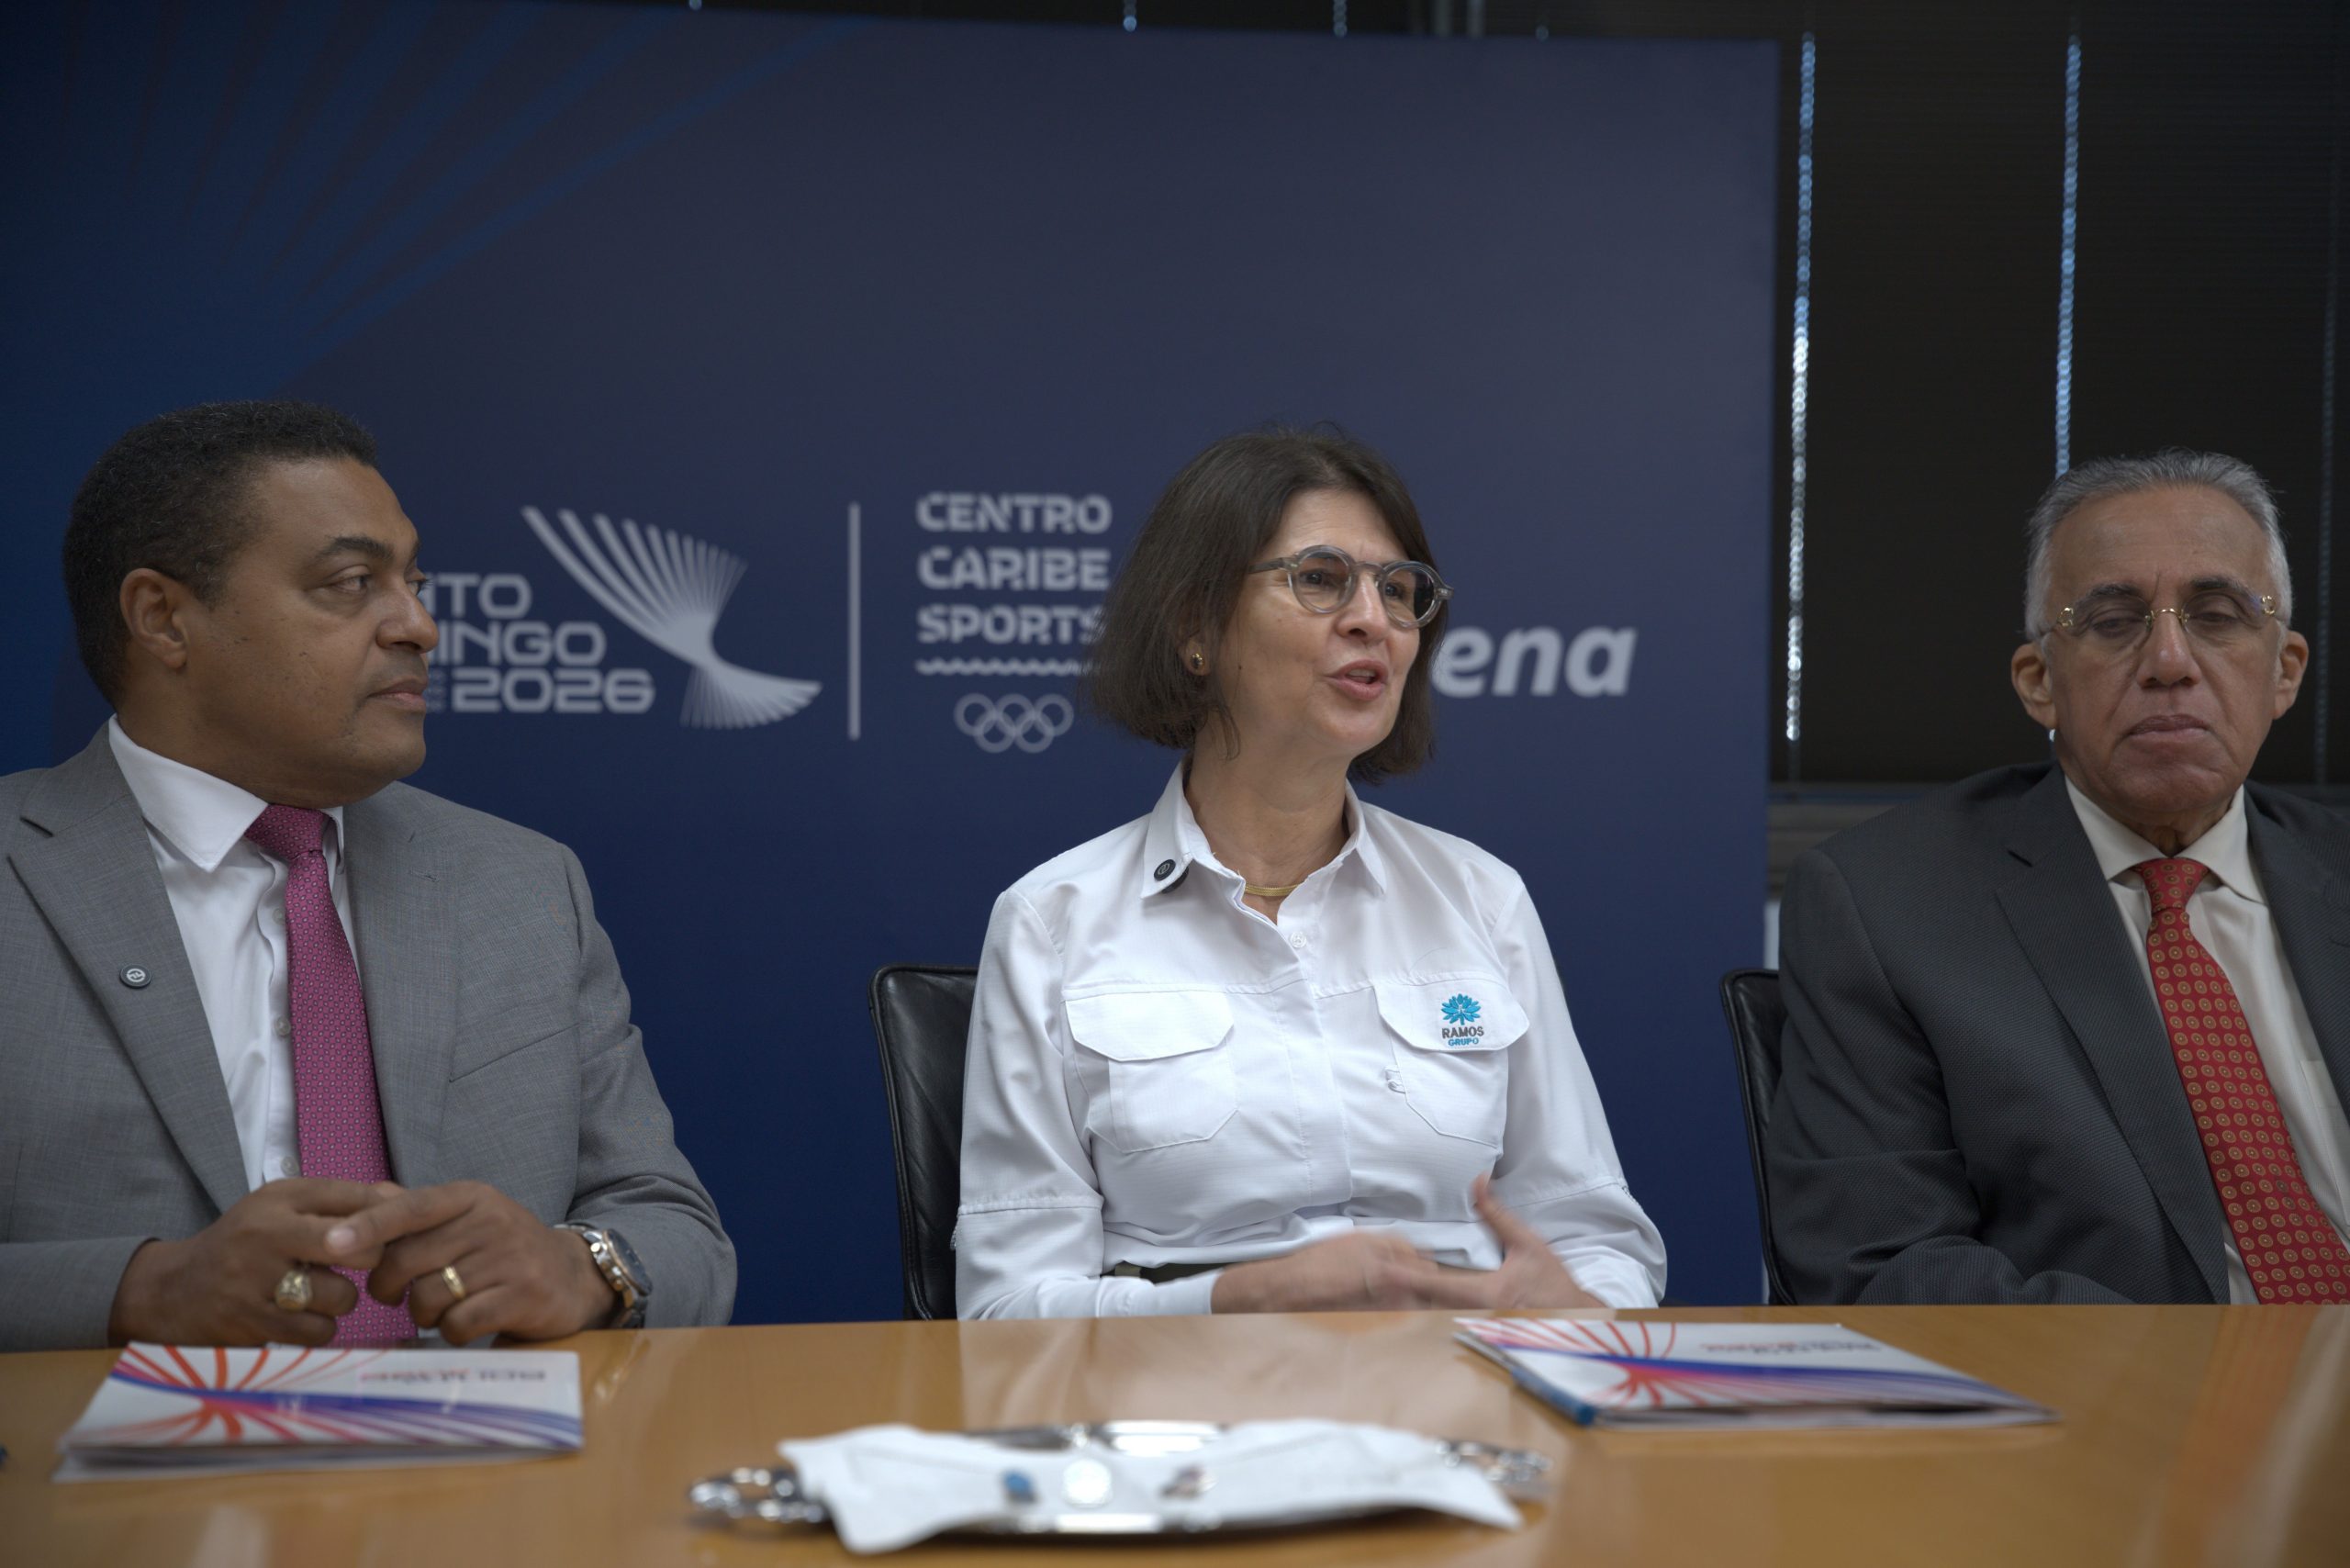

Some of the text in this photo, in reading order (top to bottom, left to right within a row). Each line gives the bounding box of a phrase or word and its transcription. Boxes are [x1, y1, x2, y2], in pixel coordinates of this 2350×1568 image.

[916, 491, 1112, 533] CENTRO
[918, 545, 1111, 590] CARIBE
[429, 621, 607, 666] INGO
[918, 603, 1105, 644] SPORTS
[1431, 626, 1638, 698] ena
[452, 668, 655, 713] 2026
[1442, 1026, 1483, 1038] RAMOS
[1449, 1037, 1479, 1046] GRUPO
